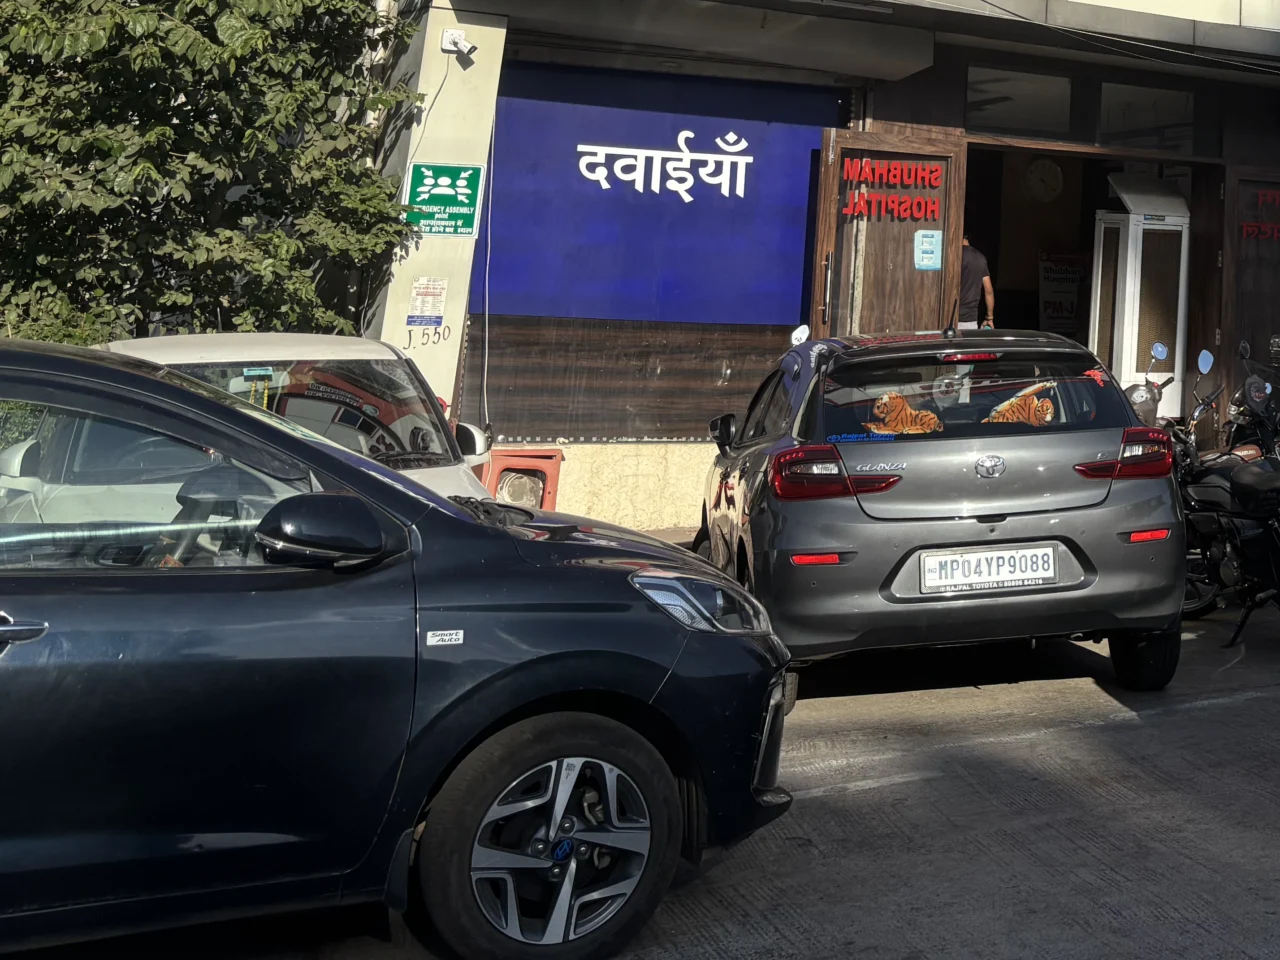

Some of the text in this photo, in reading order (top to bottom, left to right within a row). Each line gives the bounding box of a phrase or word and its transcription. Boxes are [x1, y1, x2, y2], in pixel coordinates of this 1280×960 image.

[577, 130, 754, 203] दवाईयाँ
[445, 206, 475, 214] ASSEMBLY
[421, 325, 451, 346] 550
[856, 462, 907, 472] GLANZA
[938, 552, 1050, 580] MP04YP9088
[946, 584, 971, 592] RAJPAL
[972, 581, 997, 590] TOYOTA
[430, 631, 460, 639] Smart
